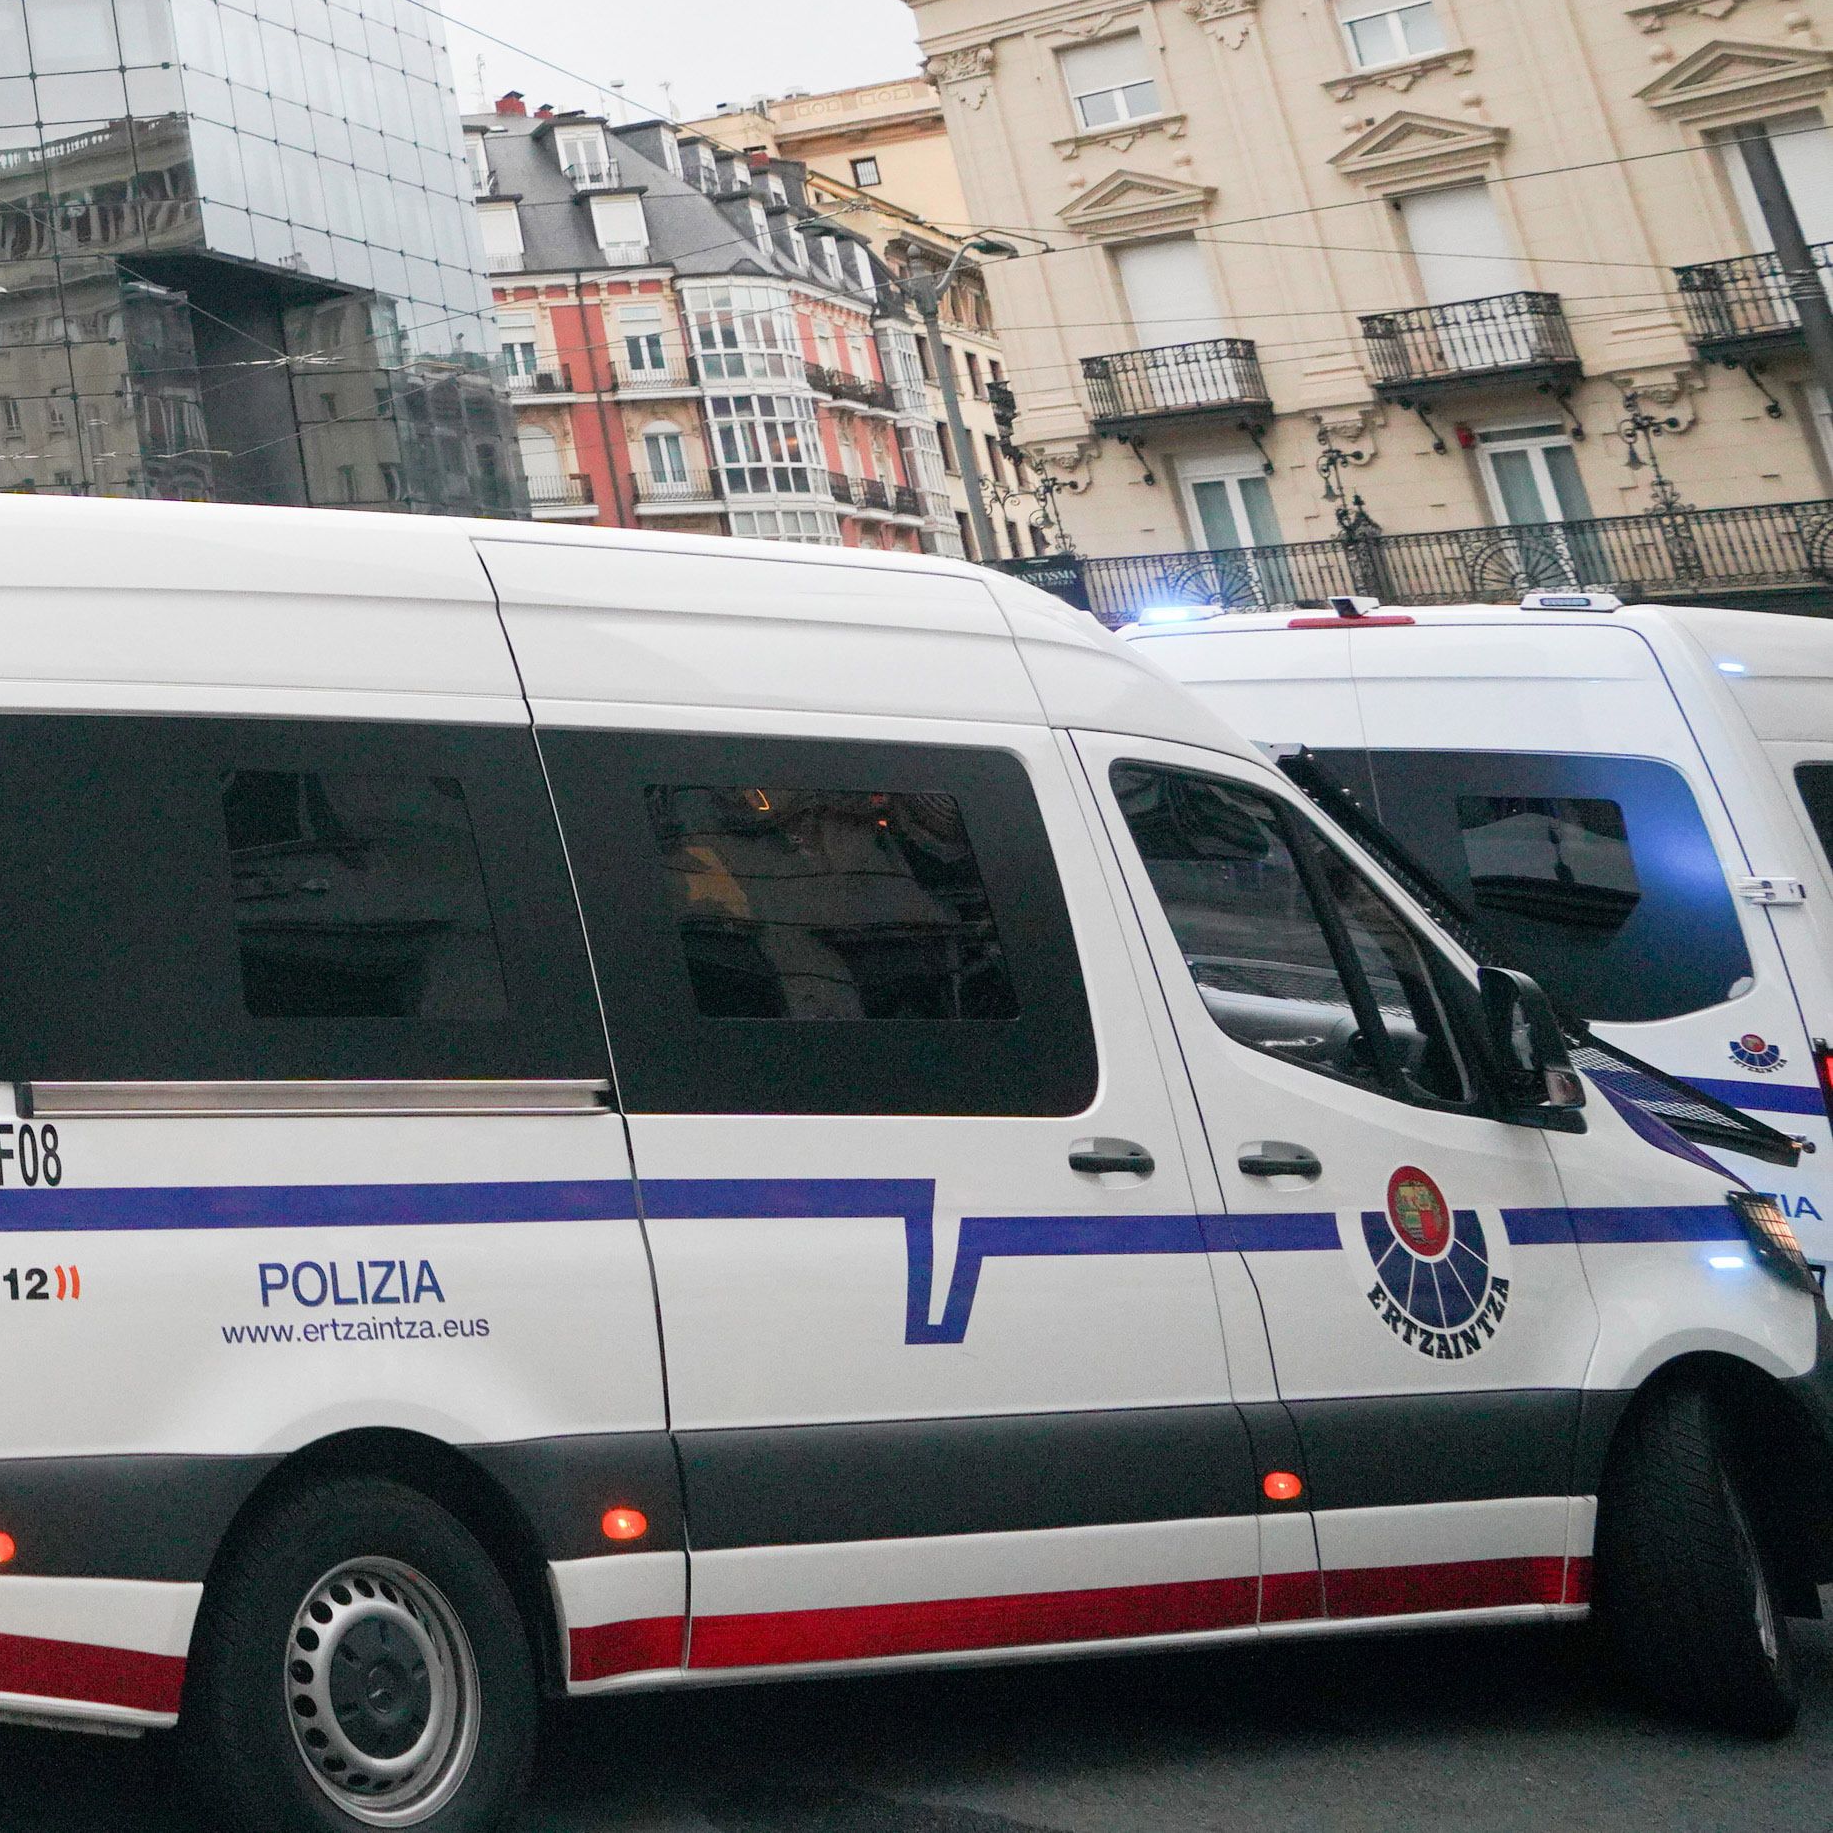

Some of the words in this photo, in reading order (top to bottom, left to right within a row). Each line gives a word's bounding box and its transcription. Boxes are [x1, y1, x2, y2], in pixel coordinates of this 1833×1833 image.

[258, 1259, 446, 1308] POLIZIA
[221, 1315, 491, 1345] www.ertzaintza.eus
[1367, 1276, 1510, 1360] ERTZAINTZA
